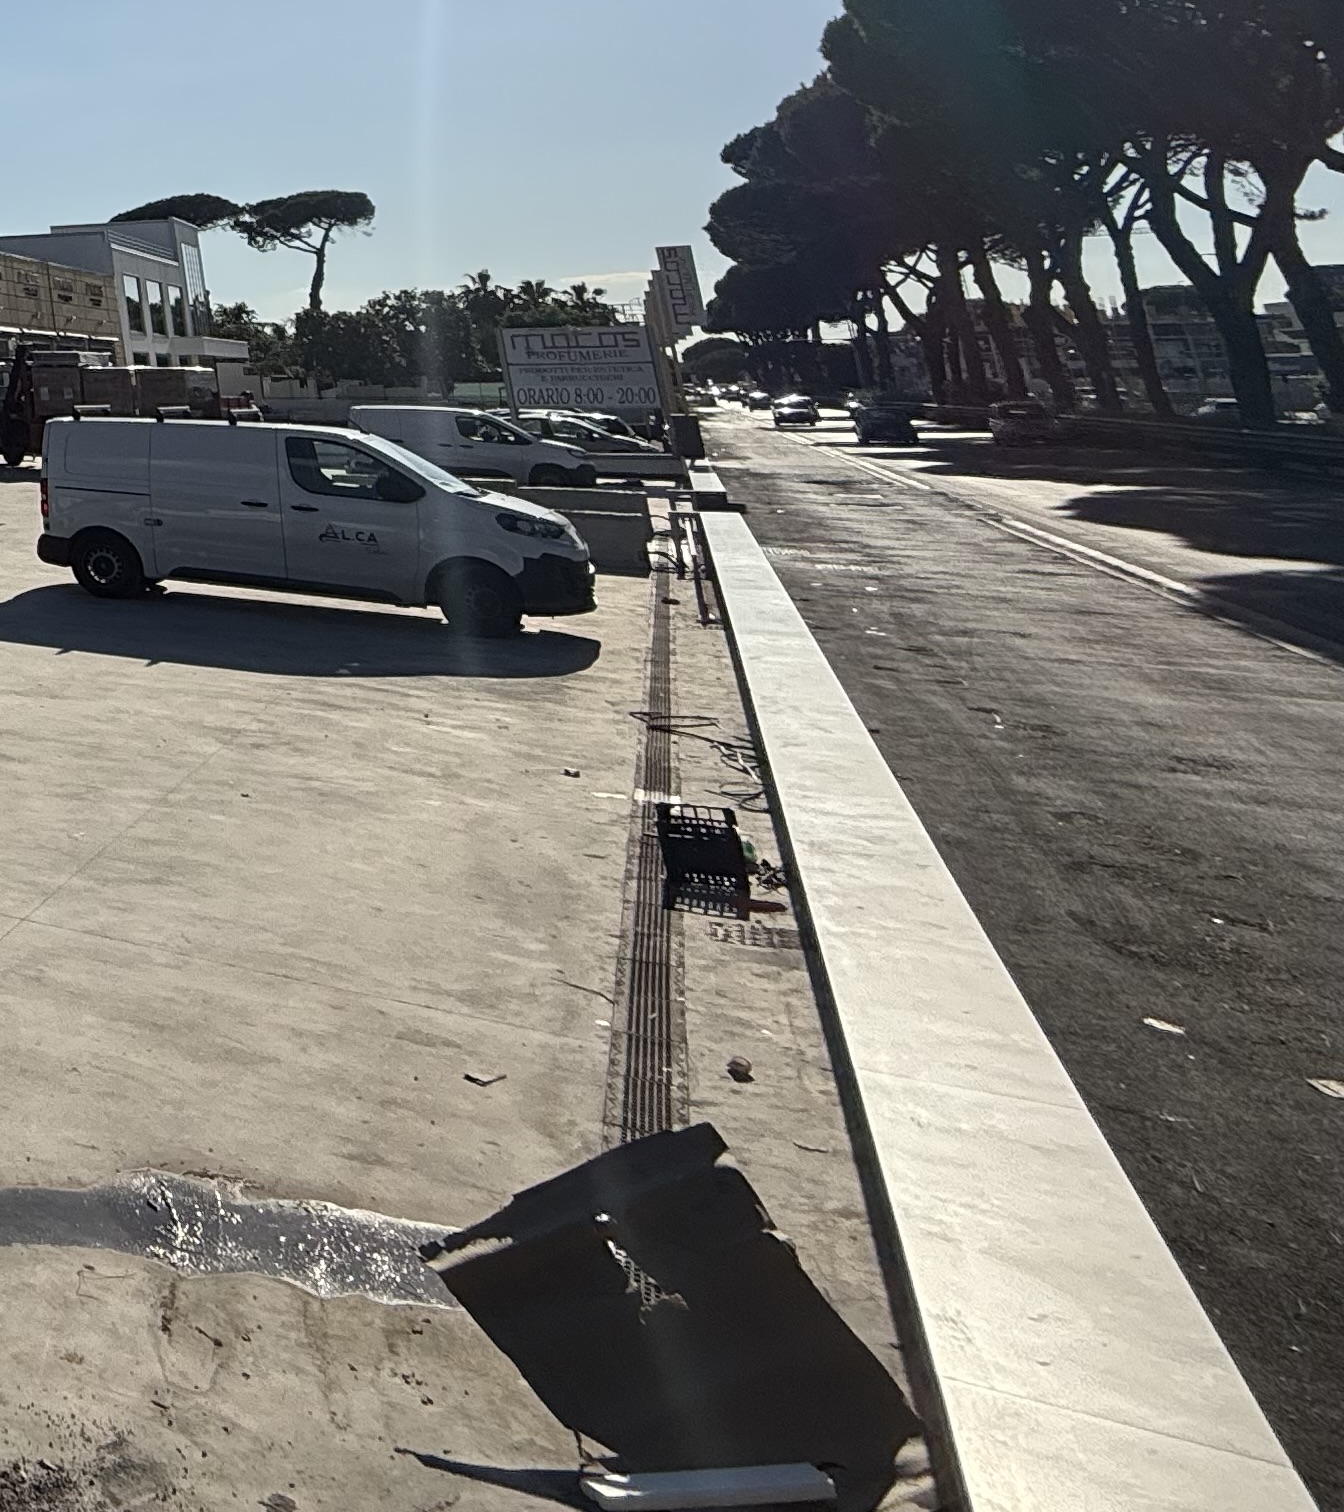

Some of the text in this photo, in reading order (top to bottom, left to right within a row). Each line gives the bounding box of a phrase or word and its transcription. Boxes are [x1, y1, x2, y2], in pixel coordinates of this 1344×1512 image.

[526, 349, 631, 362] PROFUMERIE
[517, 387, 570, 405] ORARIO
[574, 387, 604, 405] 8:00
[616, 387, 656, 404] 20:00
